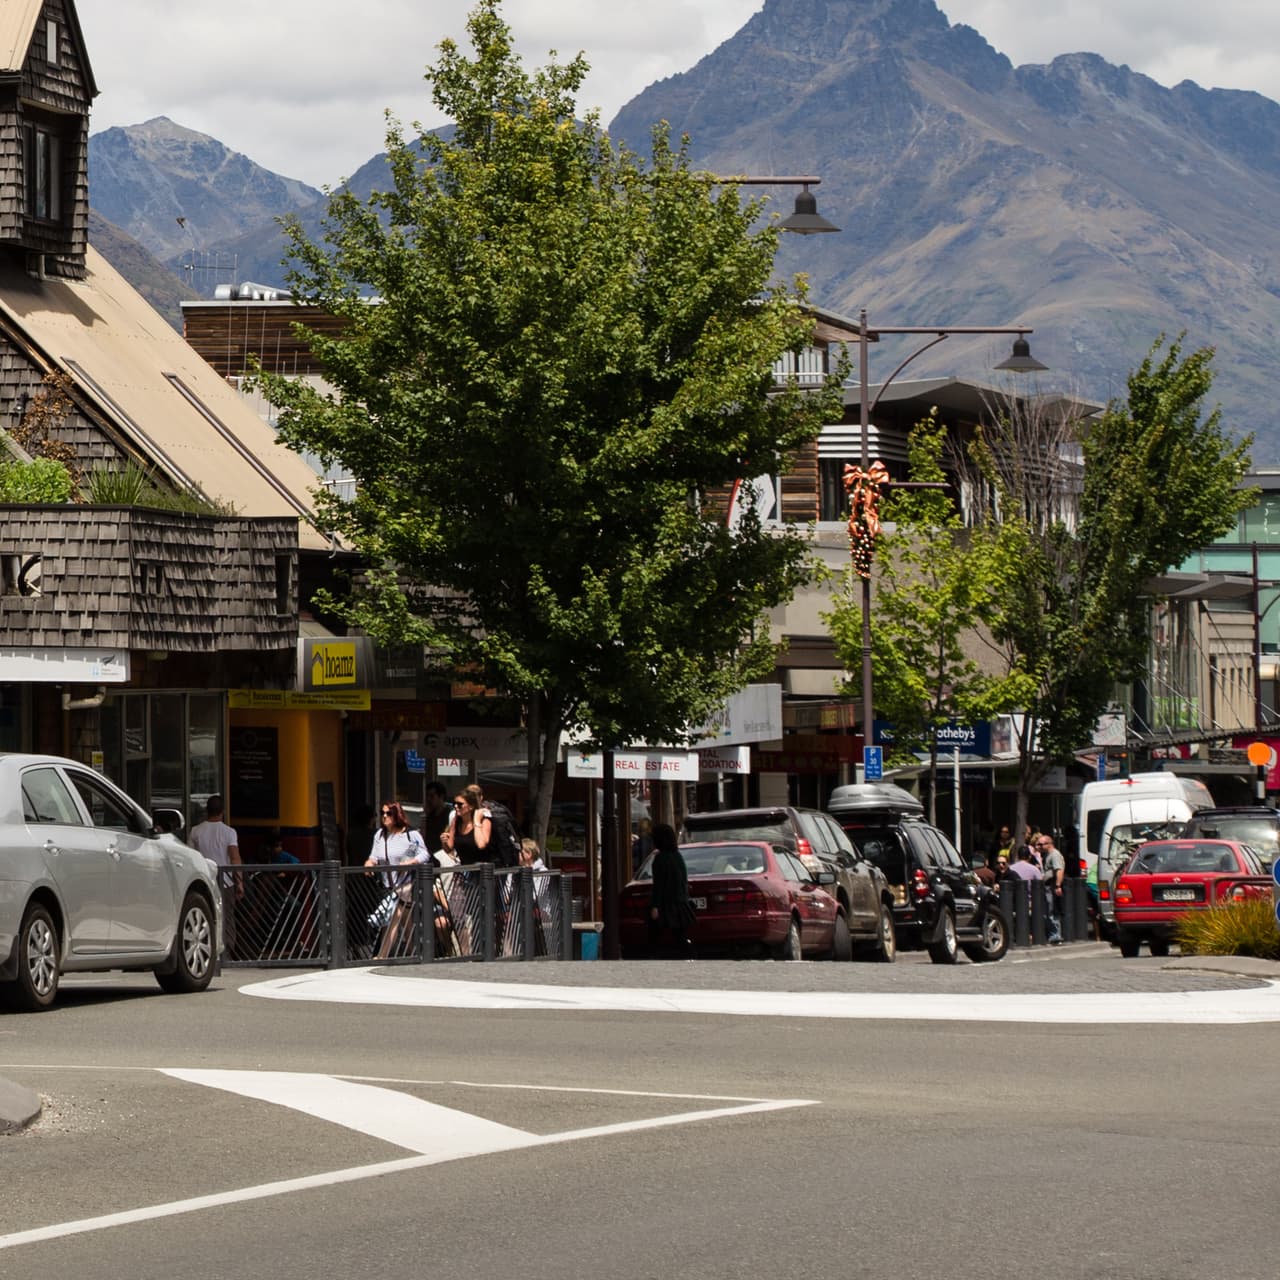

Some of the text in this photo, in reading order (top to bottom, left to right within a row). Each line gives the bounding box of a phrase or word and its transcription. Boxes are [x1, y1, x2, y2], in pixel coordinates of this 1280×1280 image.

[324, 647, 354, 679] hoamz
[445, 735, 480, 750] apex
[615, 759, 680, 772] REAL ESTATE
